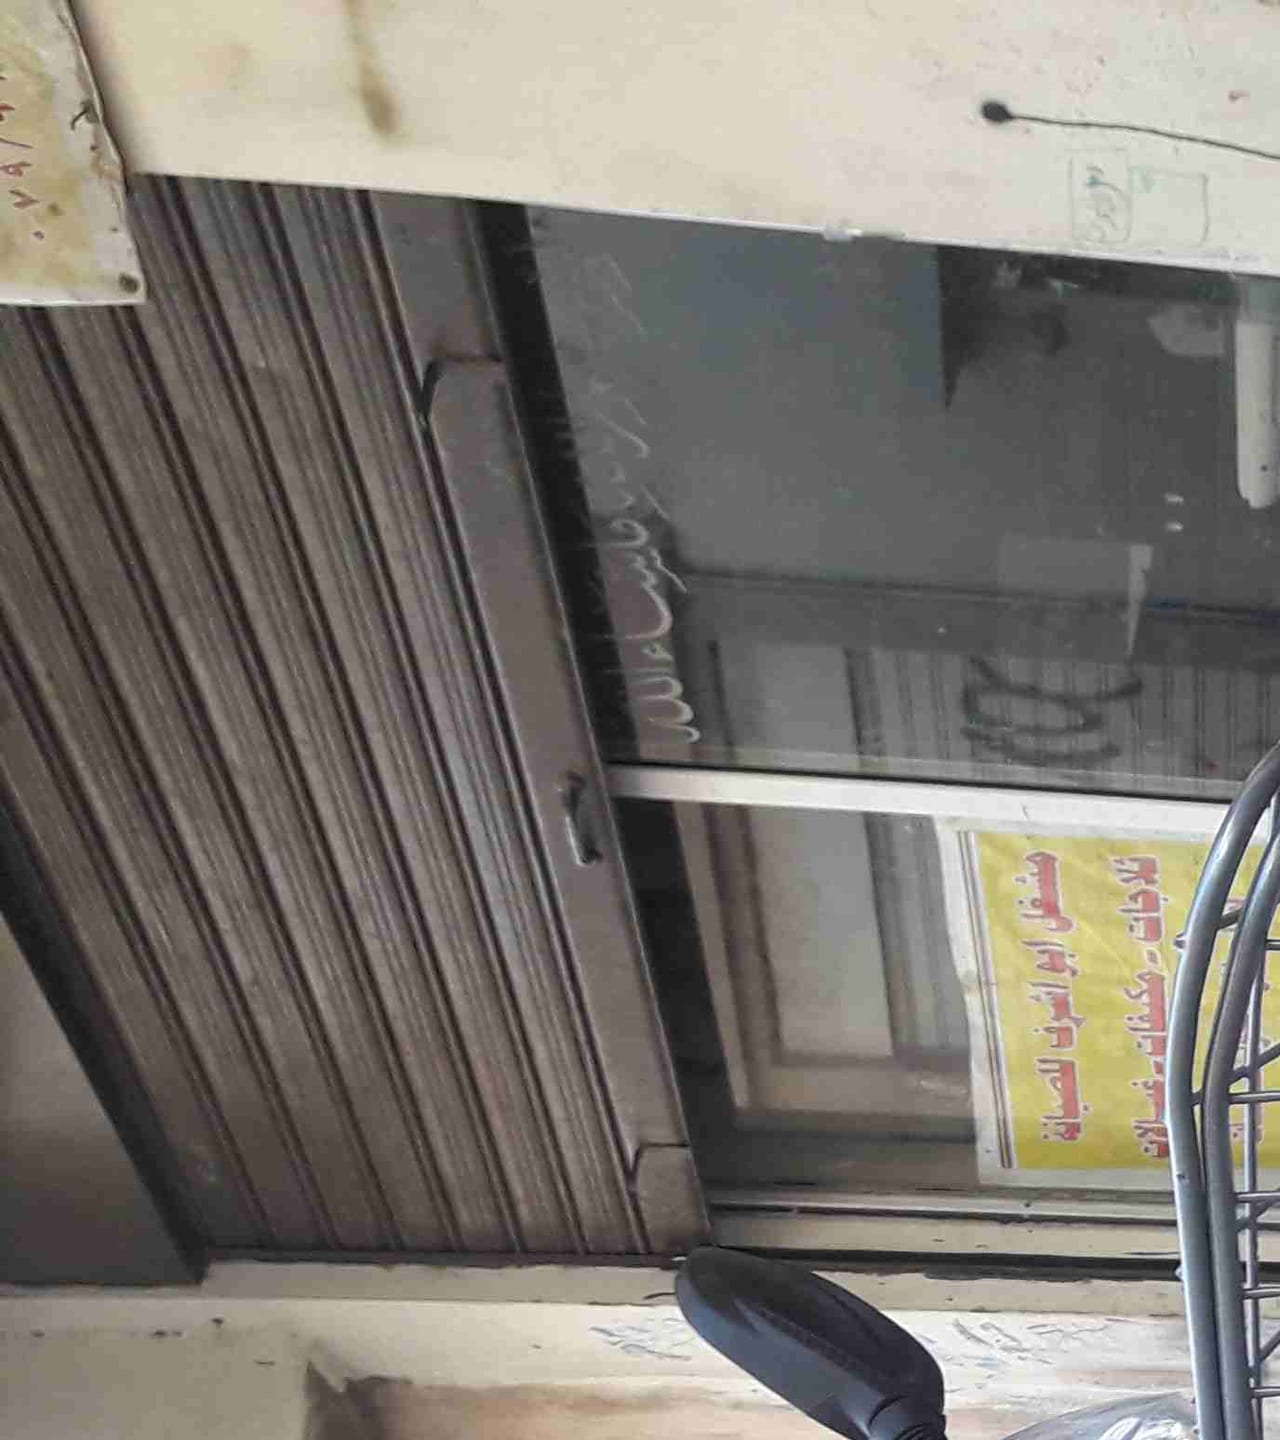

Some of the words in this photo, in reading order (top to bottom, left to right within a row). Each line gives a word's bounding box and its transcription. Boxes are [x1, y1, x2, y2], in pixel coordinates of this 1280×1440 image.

[605, 667, 700, 743] الله
[1014, 852, 1073, 932] مشغل
[1110, 856, 1168, 942] ثلاجات
[1023, 940, 1079, 977] ابو
[1028, 982, 1085, 1049] اشرف
[1034, 1057, 1091, 1142] للصيانة
